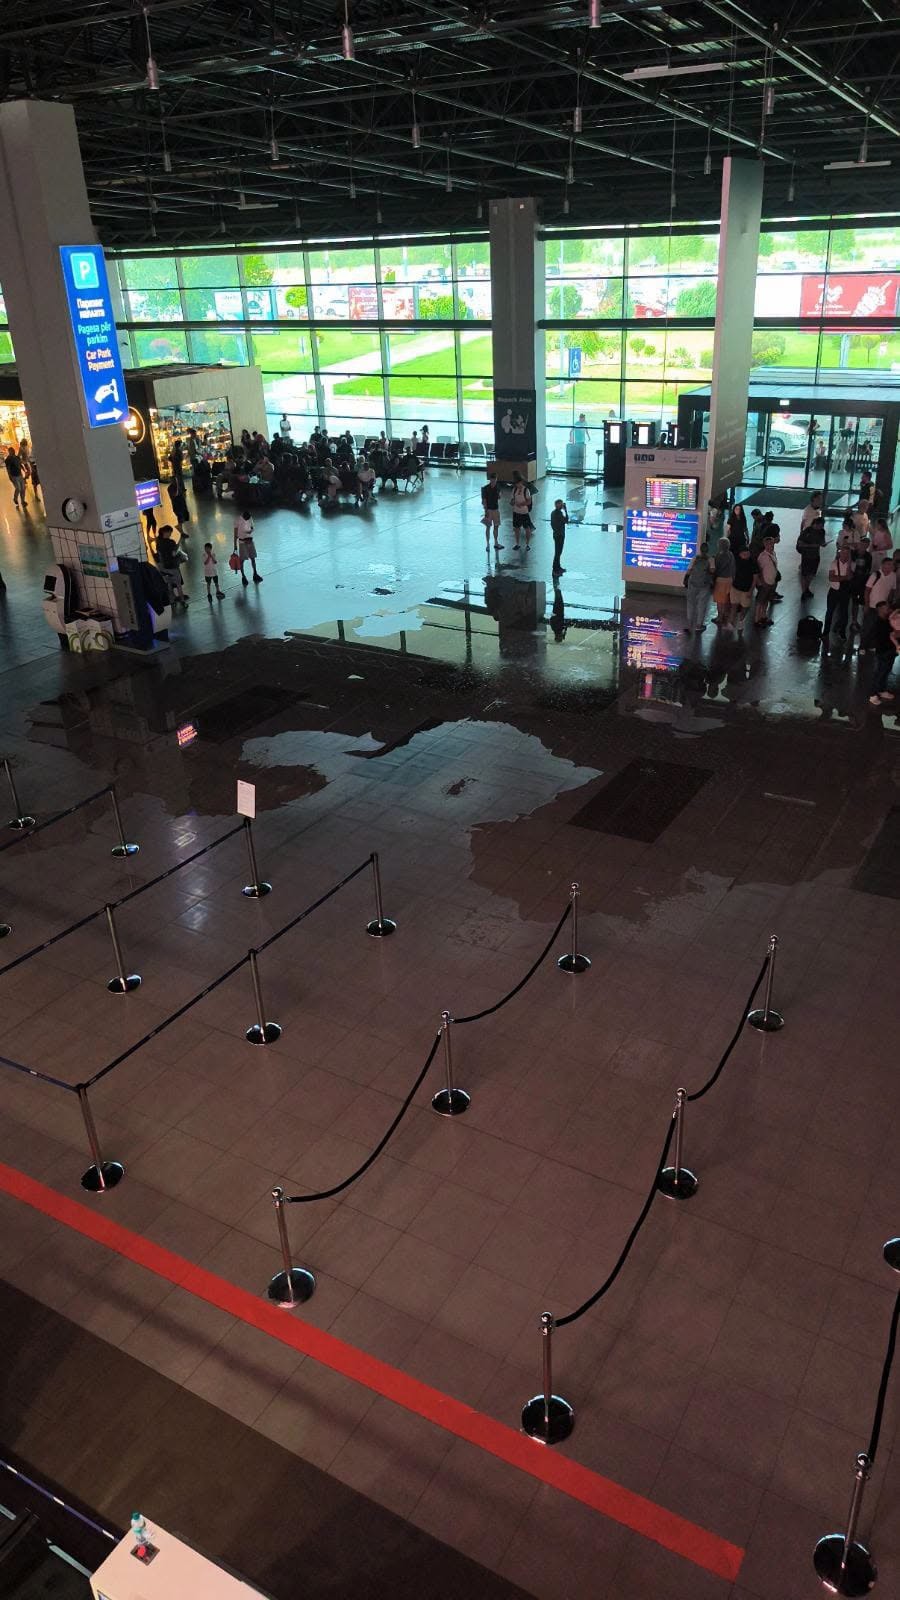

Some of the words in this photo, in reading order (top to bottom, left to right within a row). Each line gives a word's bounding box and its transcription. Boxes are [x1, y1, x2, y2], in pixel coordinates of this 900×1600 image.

[80, 261, 91, 280] P
[85, 350, 97, 361] Car
[97, 347, 112, 359] Park
[87, 359, 115, 372] Payment
